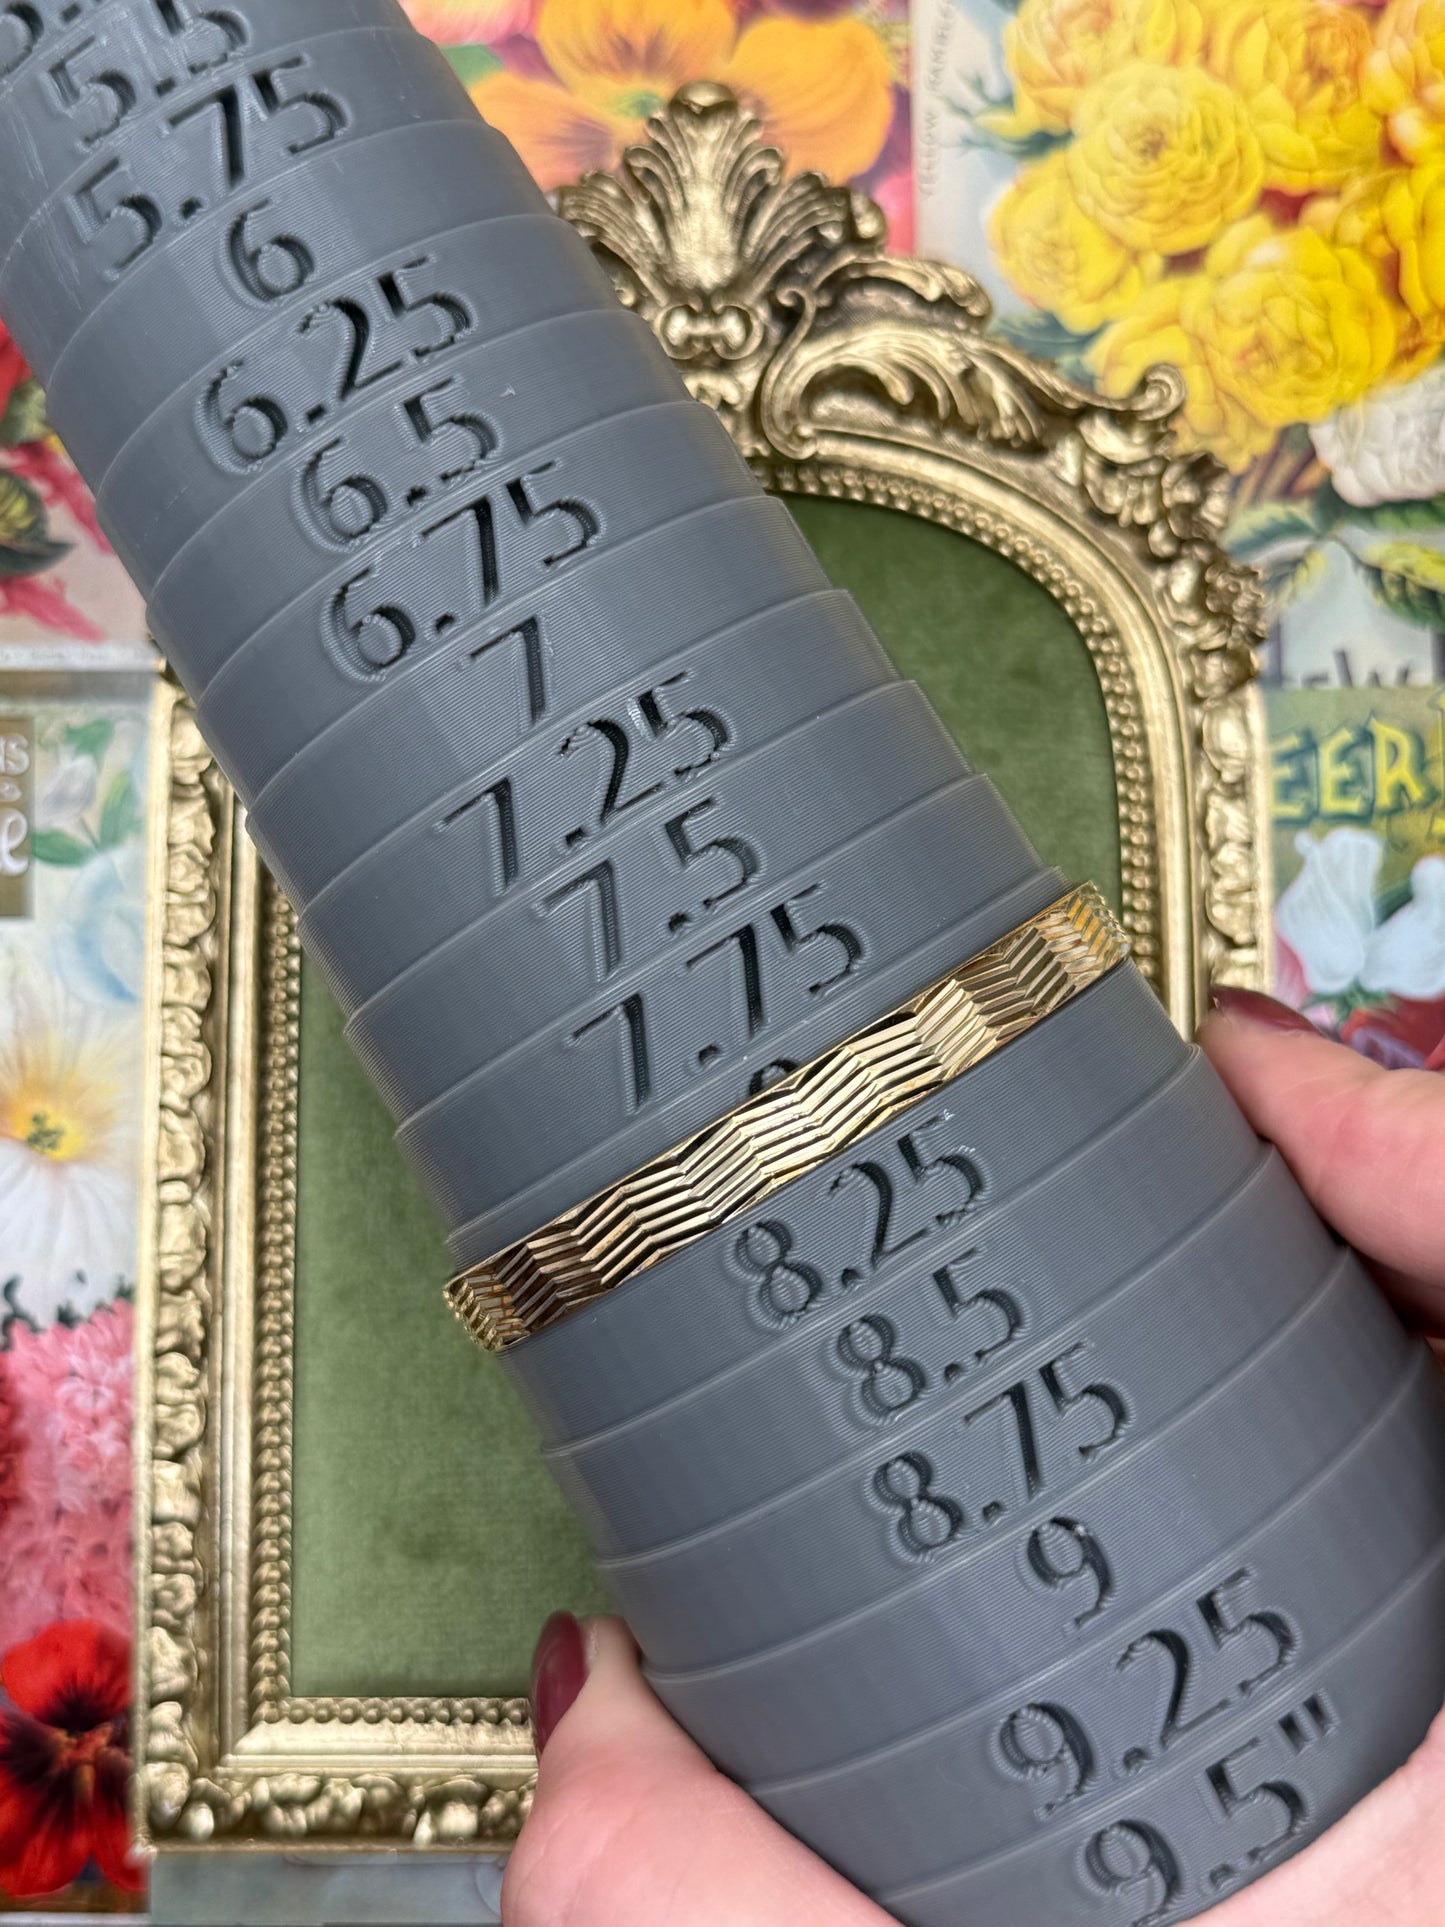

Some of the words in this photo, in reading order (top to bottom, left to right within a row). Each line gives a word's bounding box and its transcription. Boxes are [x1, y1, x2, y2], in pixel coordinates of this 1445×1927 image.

[70, 55, 350, 282] 5.75
[222, 198, 316, 308] 6
[197, 255, 477, 474] 6.25
[294, 377, 502, 552] 6.5
[323, 459, 605, 681] 6.75
[457, 615, 552, 726] 7
[434, 668, 737, 895] 7.25
[532, 797, 766, 981] 7.5
[564, 880, 870, 1113] 7.75
[725, 1109, 988, 1328] 8.25
[826, 1247, 1027, 1428] 8.5
[866, 1338, 1133, 1561] 8.75
[1018, 1515, 1116, 1632] 9
[990, 1566, 1300, 1817] 9.25
